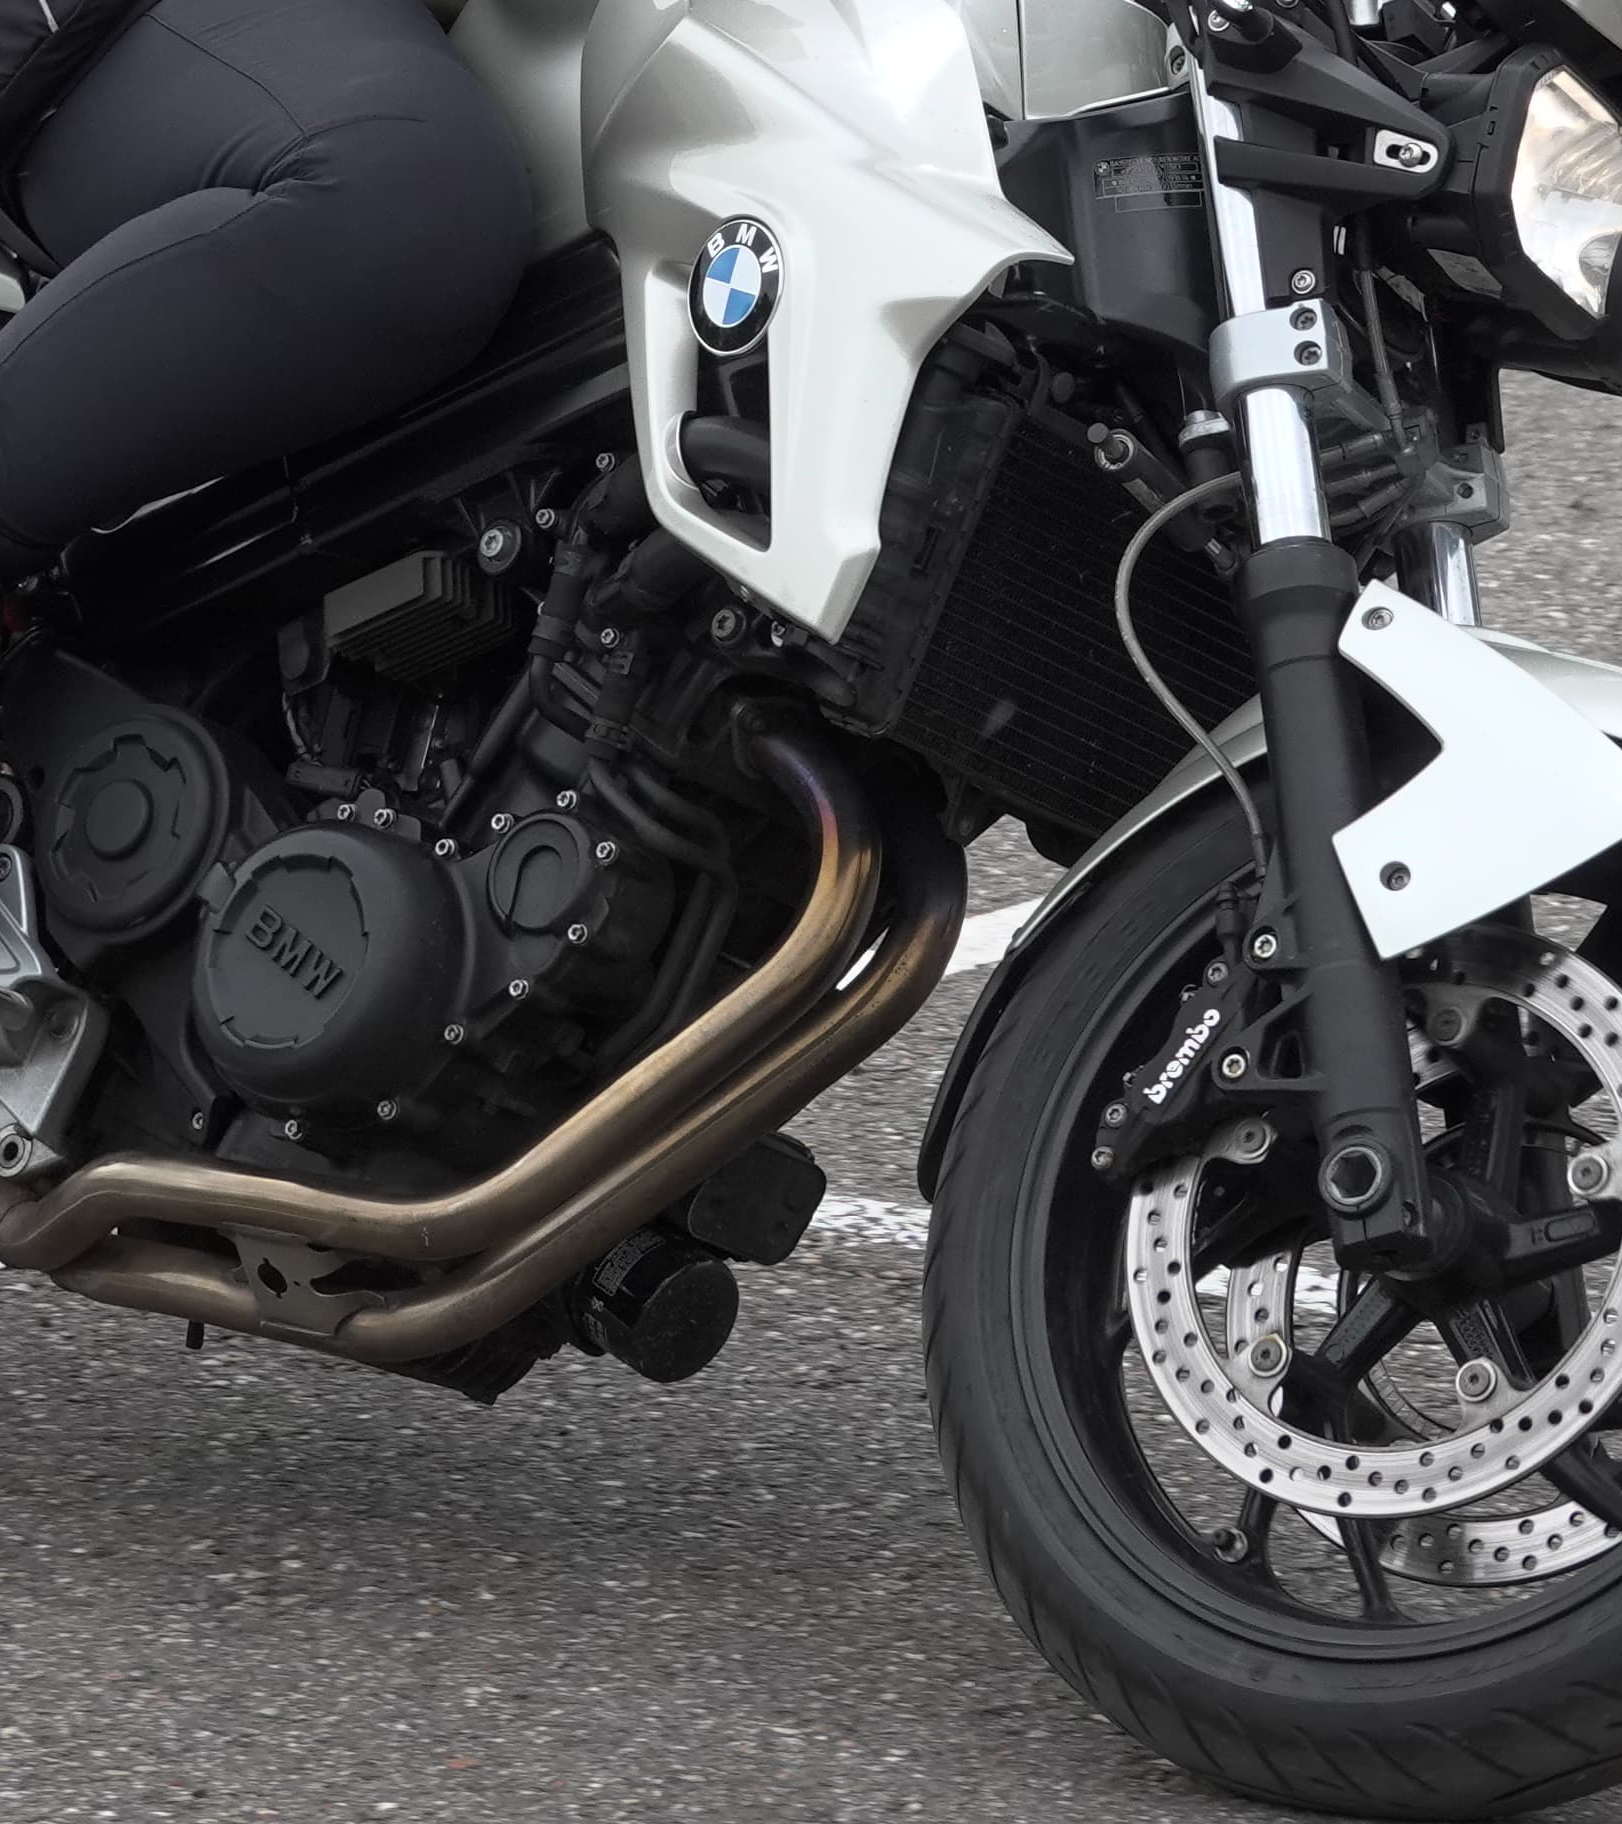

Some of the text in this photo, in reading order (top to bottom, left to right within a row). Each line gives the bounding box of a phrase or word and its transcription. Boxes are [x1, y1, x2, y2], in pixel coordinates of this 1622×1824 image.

[707, 223, 779, 273] BMW
[245, 903, 344, 1000] BMW
[1142, 1008, 1221, 1105] brembo
